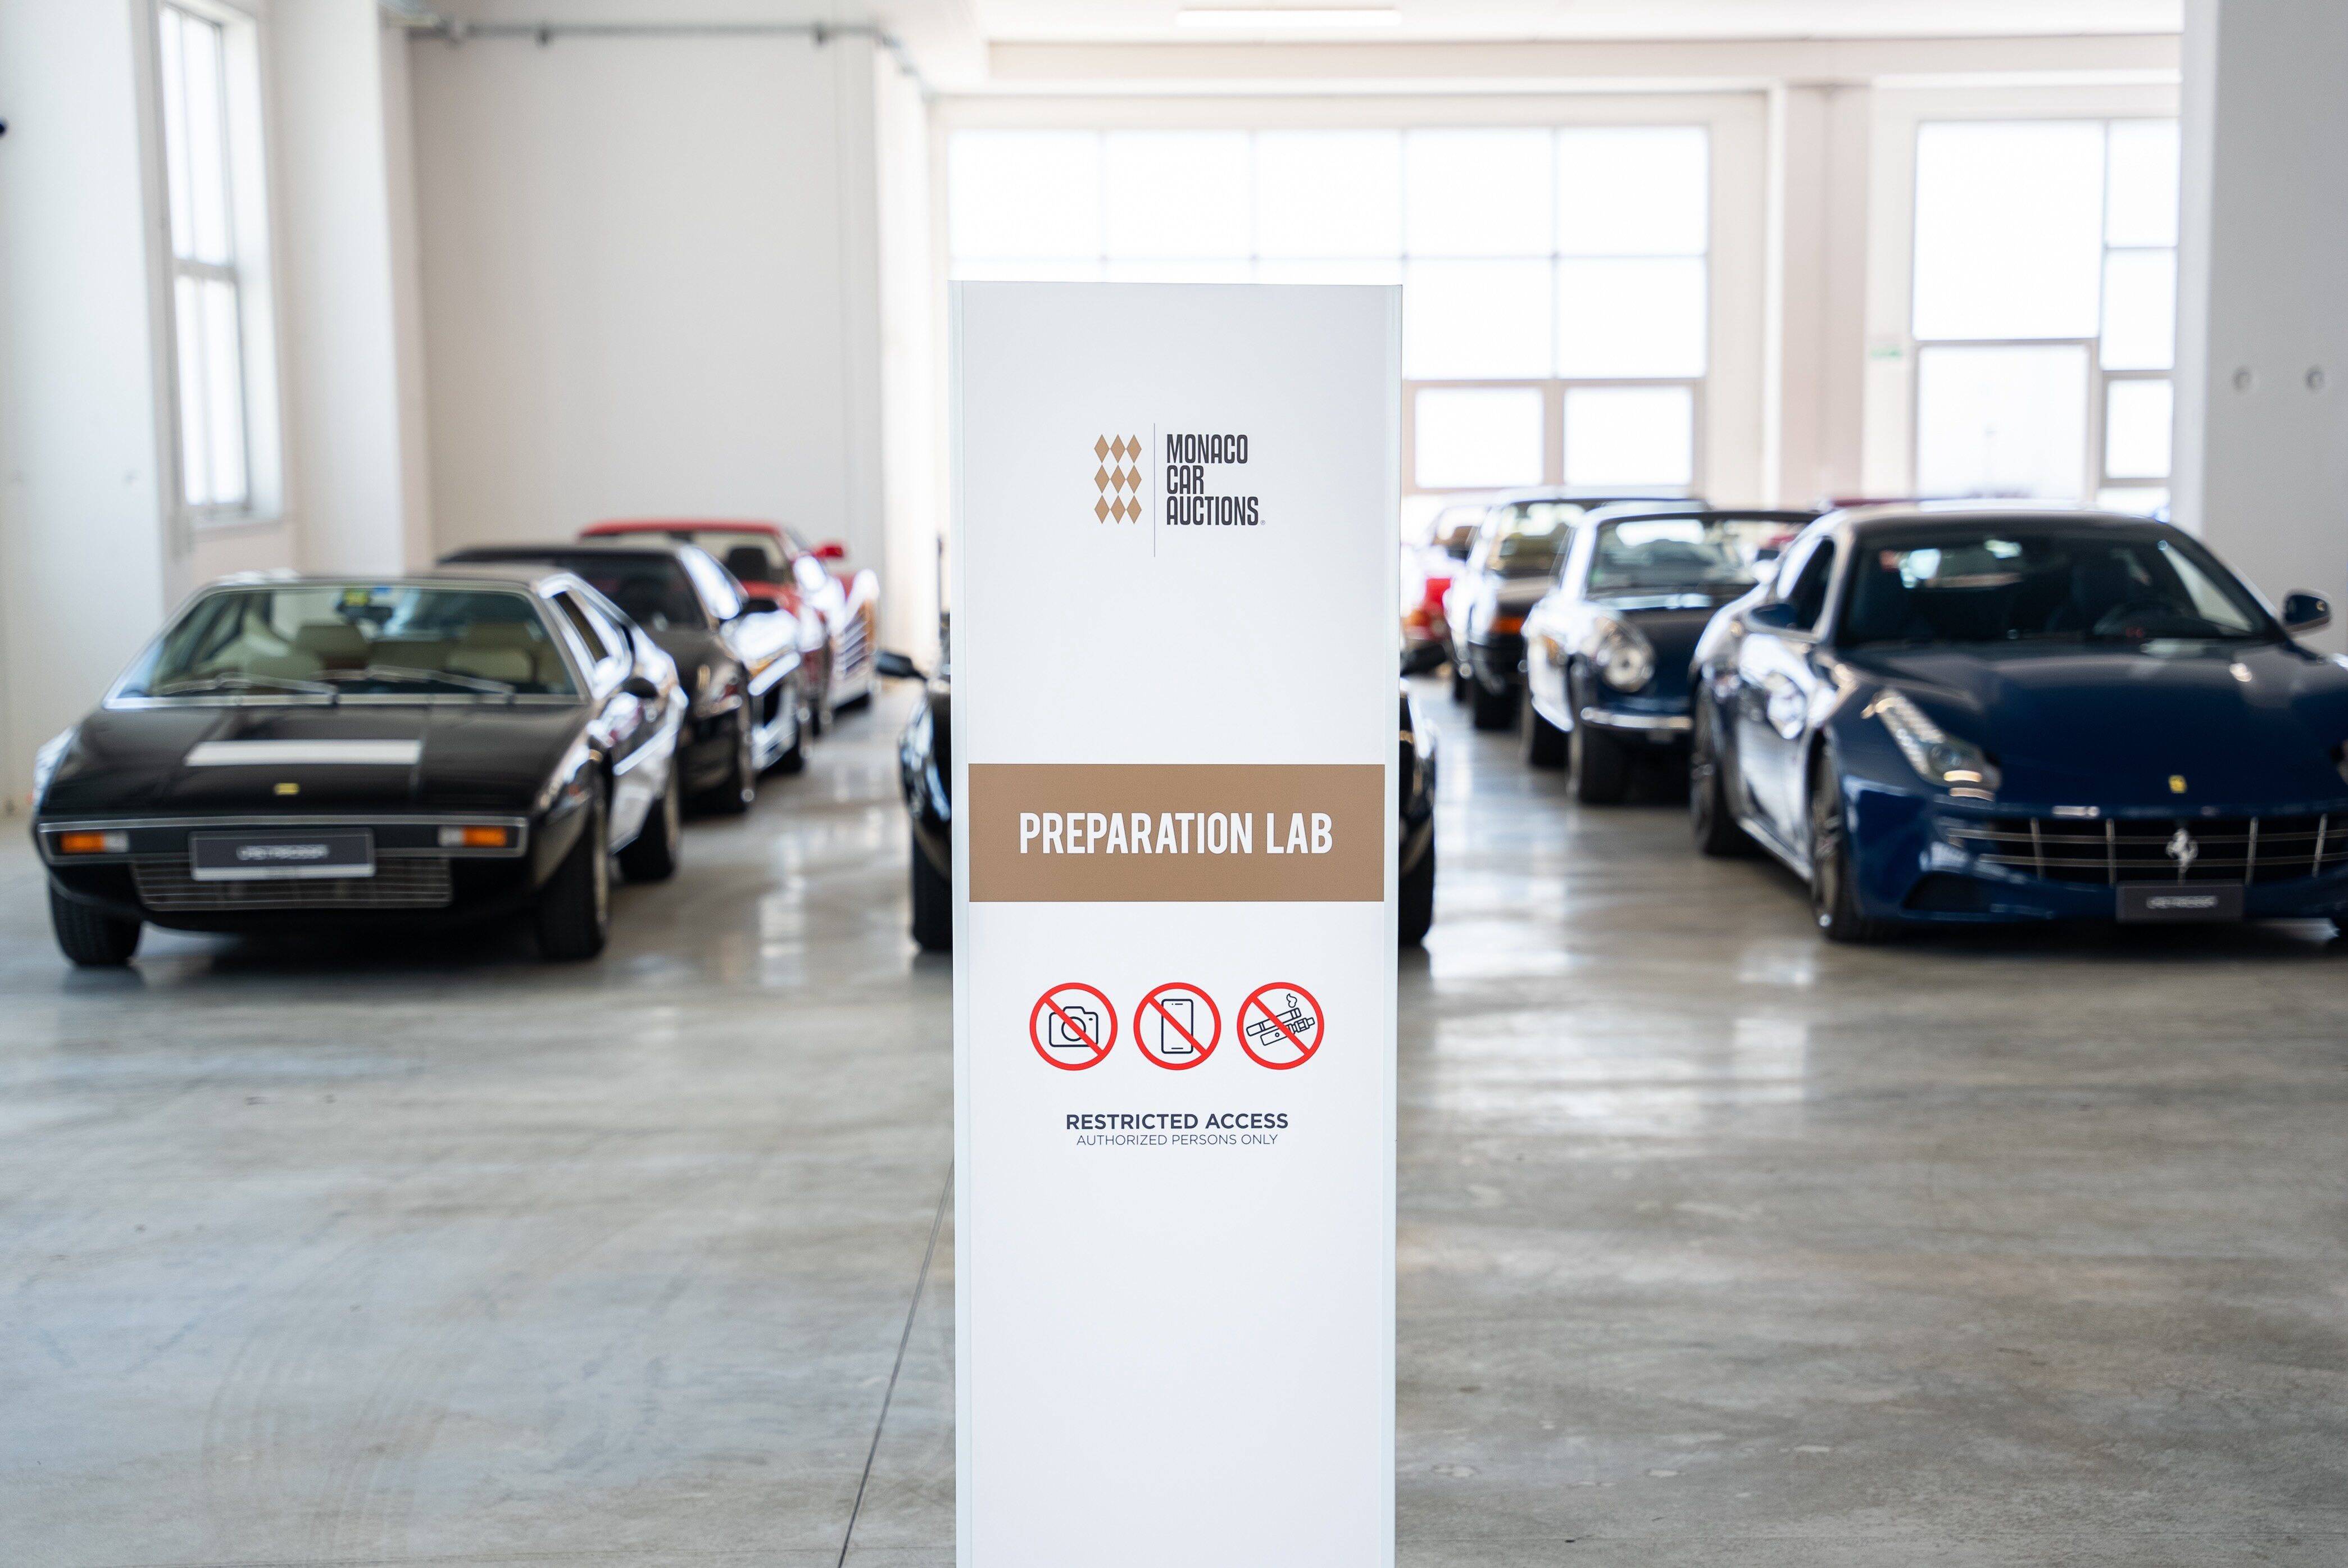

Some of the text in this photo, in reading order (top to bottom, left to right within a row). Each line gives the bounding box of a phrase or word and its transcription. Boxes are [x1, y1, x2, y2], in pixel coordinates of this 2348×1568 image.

[1166, 434, 1248, 464] MONACO
[1166, 465, 1204, 494] CAR
[1020, 812, 1333, 854] PREPARATION LAB
[1066, 1113, 1288, 1130] RESTRICTED ACCESS
[1076, 1134, 1279, 1146] AUTHORIZED PERSONS ONLY
